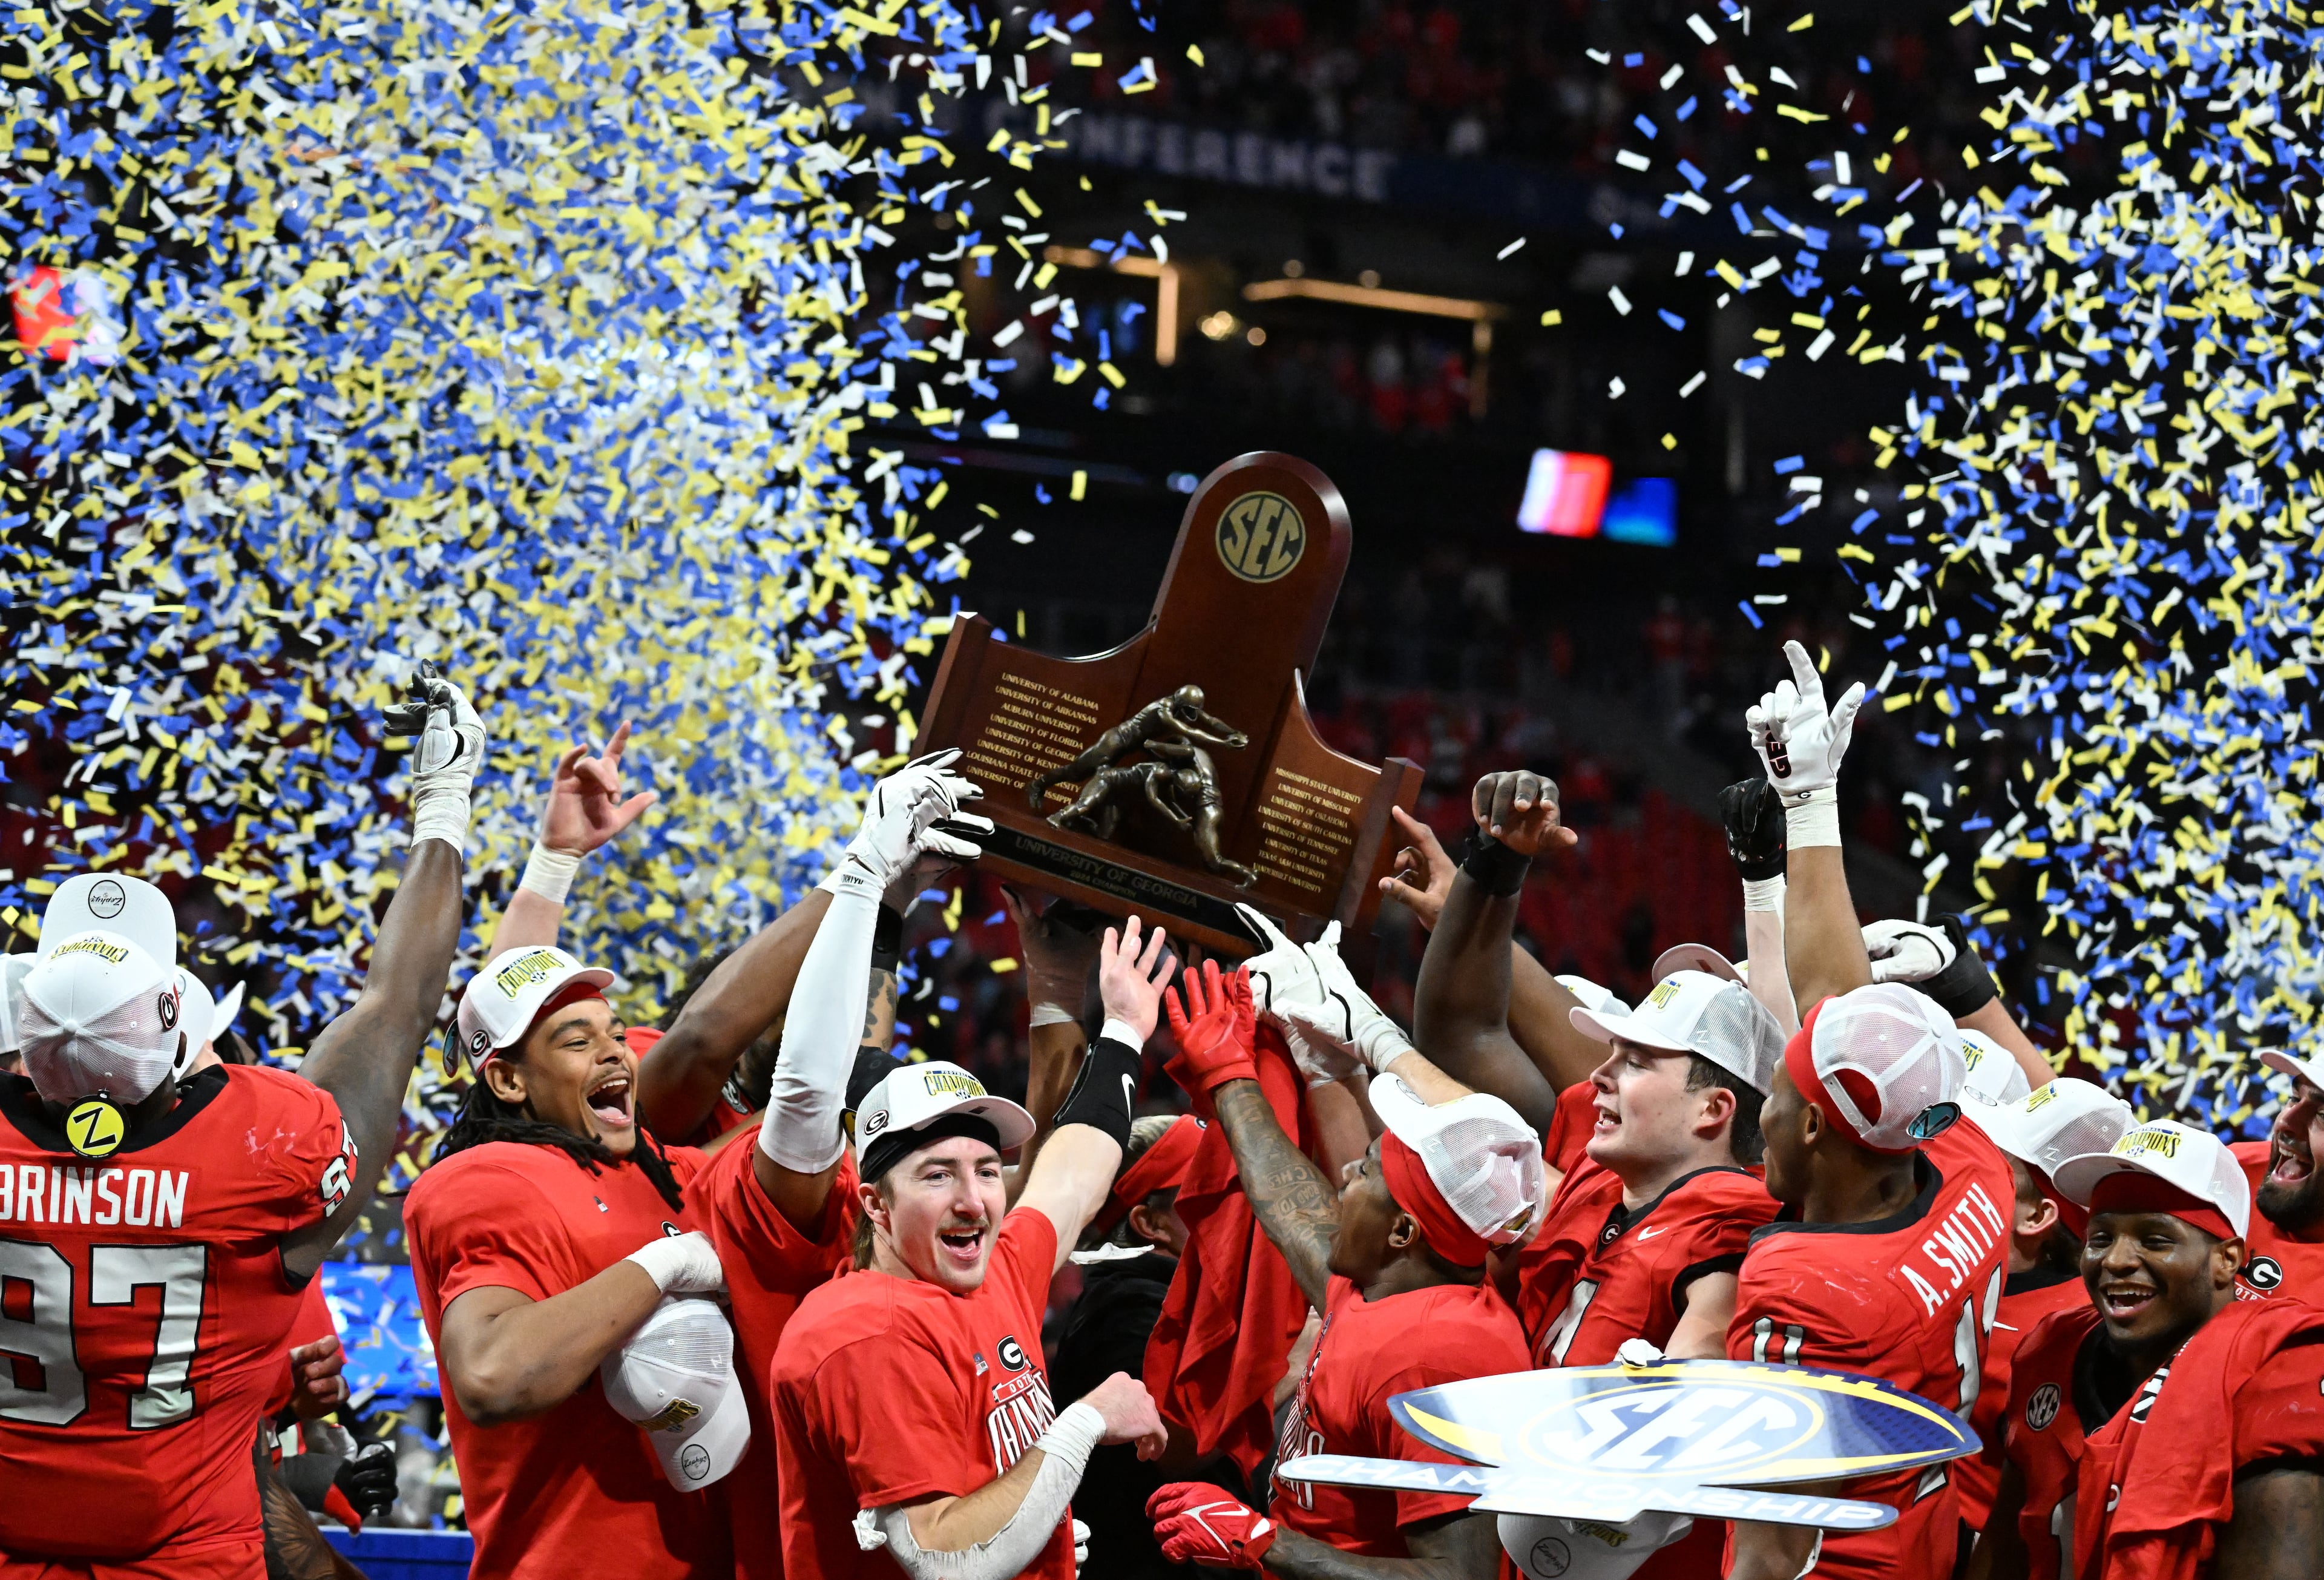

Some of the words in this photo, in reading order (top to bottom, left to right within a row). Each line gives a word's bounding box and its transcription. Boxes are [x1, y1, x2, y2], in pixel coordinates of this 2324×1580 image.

[1220, 495, 1302, 579] SEC
[995, 685, 1041, 705] UNIVERSITY
[1042, 701, 1054, 709] OF
[1054, 705, 1097, 724] ARKANSAS
[1002, 672, 1047, 693] UNIVERSITY
[1049, 688, 1061, 697] OF
[1062, 693, 1099, 711] ALABAMA
[990, 714, 1036, 734] UNIVERSITY
[1037, 729, 1049, 738] OF
[1049, 731, 1083, 750] FLORIDA
[1001, 702, 1034, 719] AUBURN
[1035, 713, 1082, 734] UNIVERSITY
[977, 739, 1023, 759] UNIVERSITY
[1024, 755, 1035, 763] OF
[1037, 757, 1061, 770] KENT
[985, 727, 1031, 747] UNIVERSITY
[1032, 742, 1044, 751] OF
[1045, 746, 1076, 762] GEORGI
[1765, 725, 1791, 778] GE
[966, 751, 1008, 770] LOUISIANA
[1009, 764, 1032, 778] STATE
[967, 765, 1013, 786] UNIVERSITY
[1014, 780, 1025, 789] OF
[1043, 789, 1072, 805] ISSIPPI
[1275, 767, 1310, 785] MISSISSIPPI
[1309, 779, 1328, 792] STATE
[1328, 786, 1362, 804] UNIVERSITY
[1278, 783, 1313, 801] UNIVERSITY
[1313, 795, 1322, 804] OF
[1322, 798, 1351, 815] MISSOURI
[1258, 805, 1292, 823] UNIVERSITY
[1292, 818, 1302, 826] OF
[1302, 821, 1322, 834] SOUTH
[1322, 830, 1352, 845] CAROLINA
[1271, 795, 1305, 812] UNIVERSITY
[1306, 808, 1315, 817] OF
[1315, 811, 1348, 829] OKLAHOMA
[1262, 821, 1296, 840] UNIVERSITY
[1296, 834, 1307, 843] OF
[1307, 837, 1339, 855] TENNESSEE
[1265, 837, 1299, 855] UNIVERSITY
[1299, 850, 1308, 858] OF
[1309, 854, 1328, 866] TEXAS
[1015, 836, 1106, 875] UNIVERSITY
[1106, 867, 1130, 882] OF
[1131, 876, 1198, 908] GEORGIA
[1253, 862, 1288, 881] VANDERBILT
[1288, 875, 1322, 893] UNIVERSITY
[1258, 849, 1278, 862] TEXAS
[1292, 861, 1325, 880] UNIVERSITY
[90, 895, 123, 906] Zephyr
[497, 952, 565, 998] CHAMPIONS
[159, 992, 180, 1030] G
[470, 1030, 489, 1056] G
[924, 1075, 985, 1096] CHAMPION
[73, 1107, 116, 1149] Z
[864, 1109, 888, 1136] G
[0, 1164, 189, 1228] BRINSON
[1603, 1225, 1620, 1243] G
[1922, 1182, 2005, 1290] SMITH
[1900, 1264, 1950, 1318] A.
[2245, 1255, 2283, 1290] G
[0, 1237, 208, 1430] 97
[997, 1334, 1026, 1372] G
[2028, 1384, 2059, 1427] SEC
[1541, 1387, 1797, 1470] SEC
[684, 1455, 708, 1469] Zephyr
[1290, 1457, 1885, 1524] CHAMPIONSHIP
